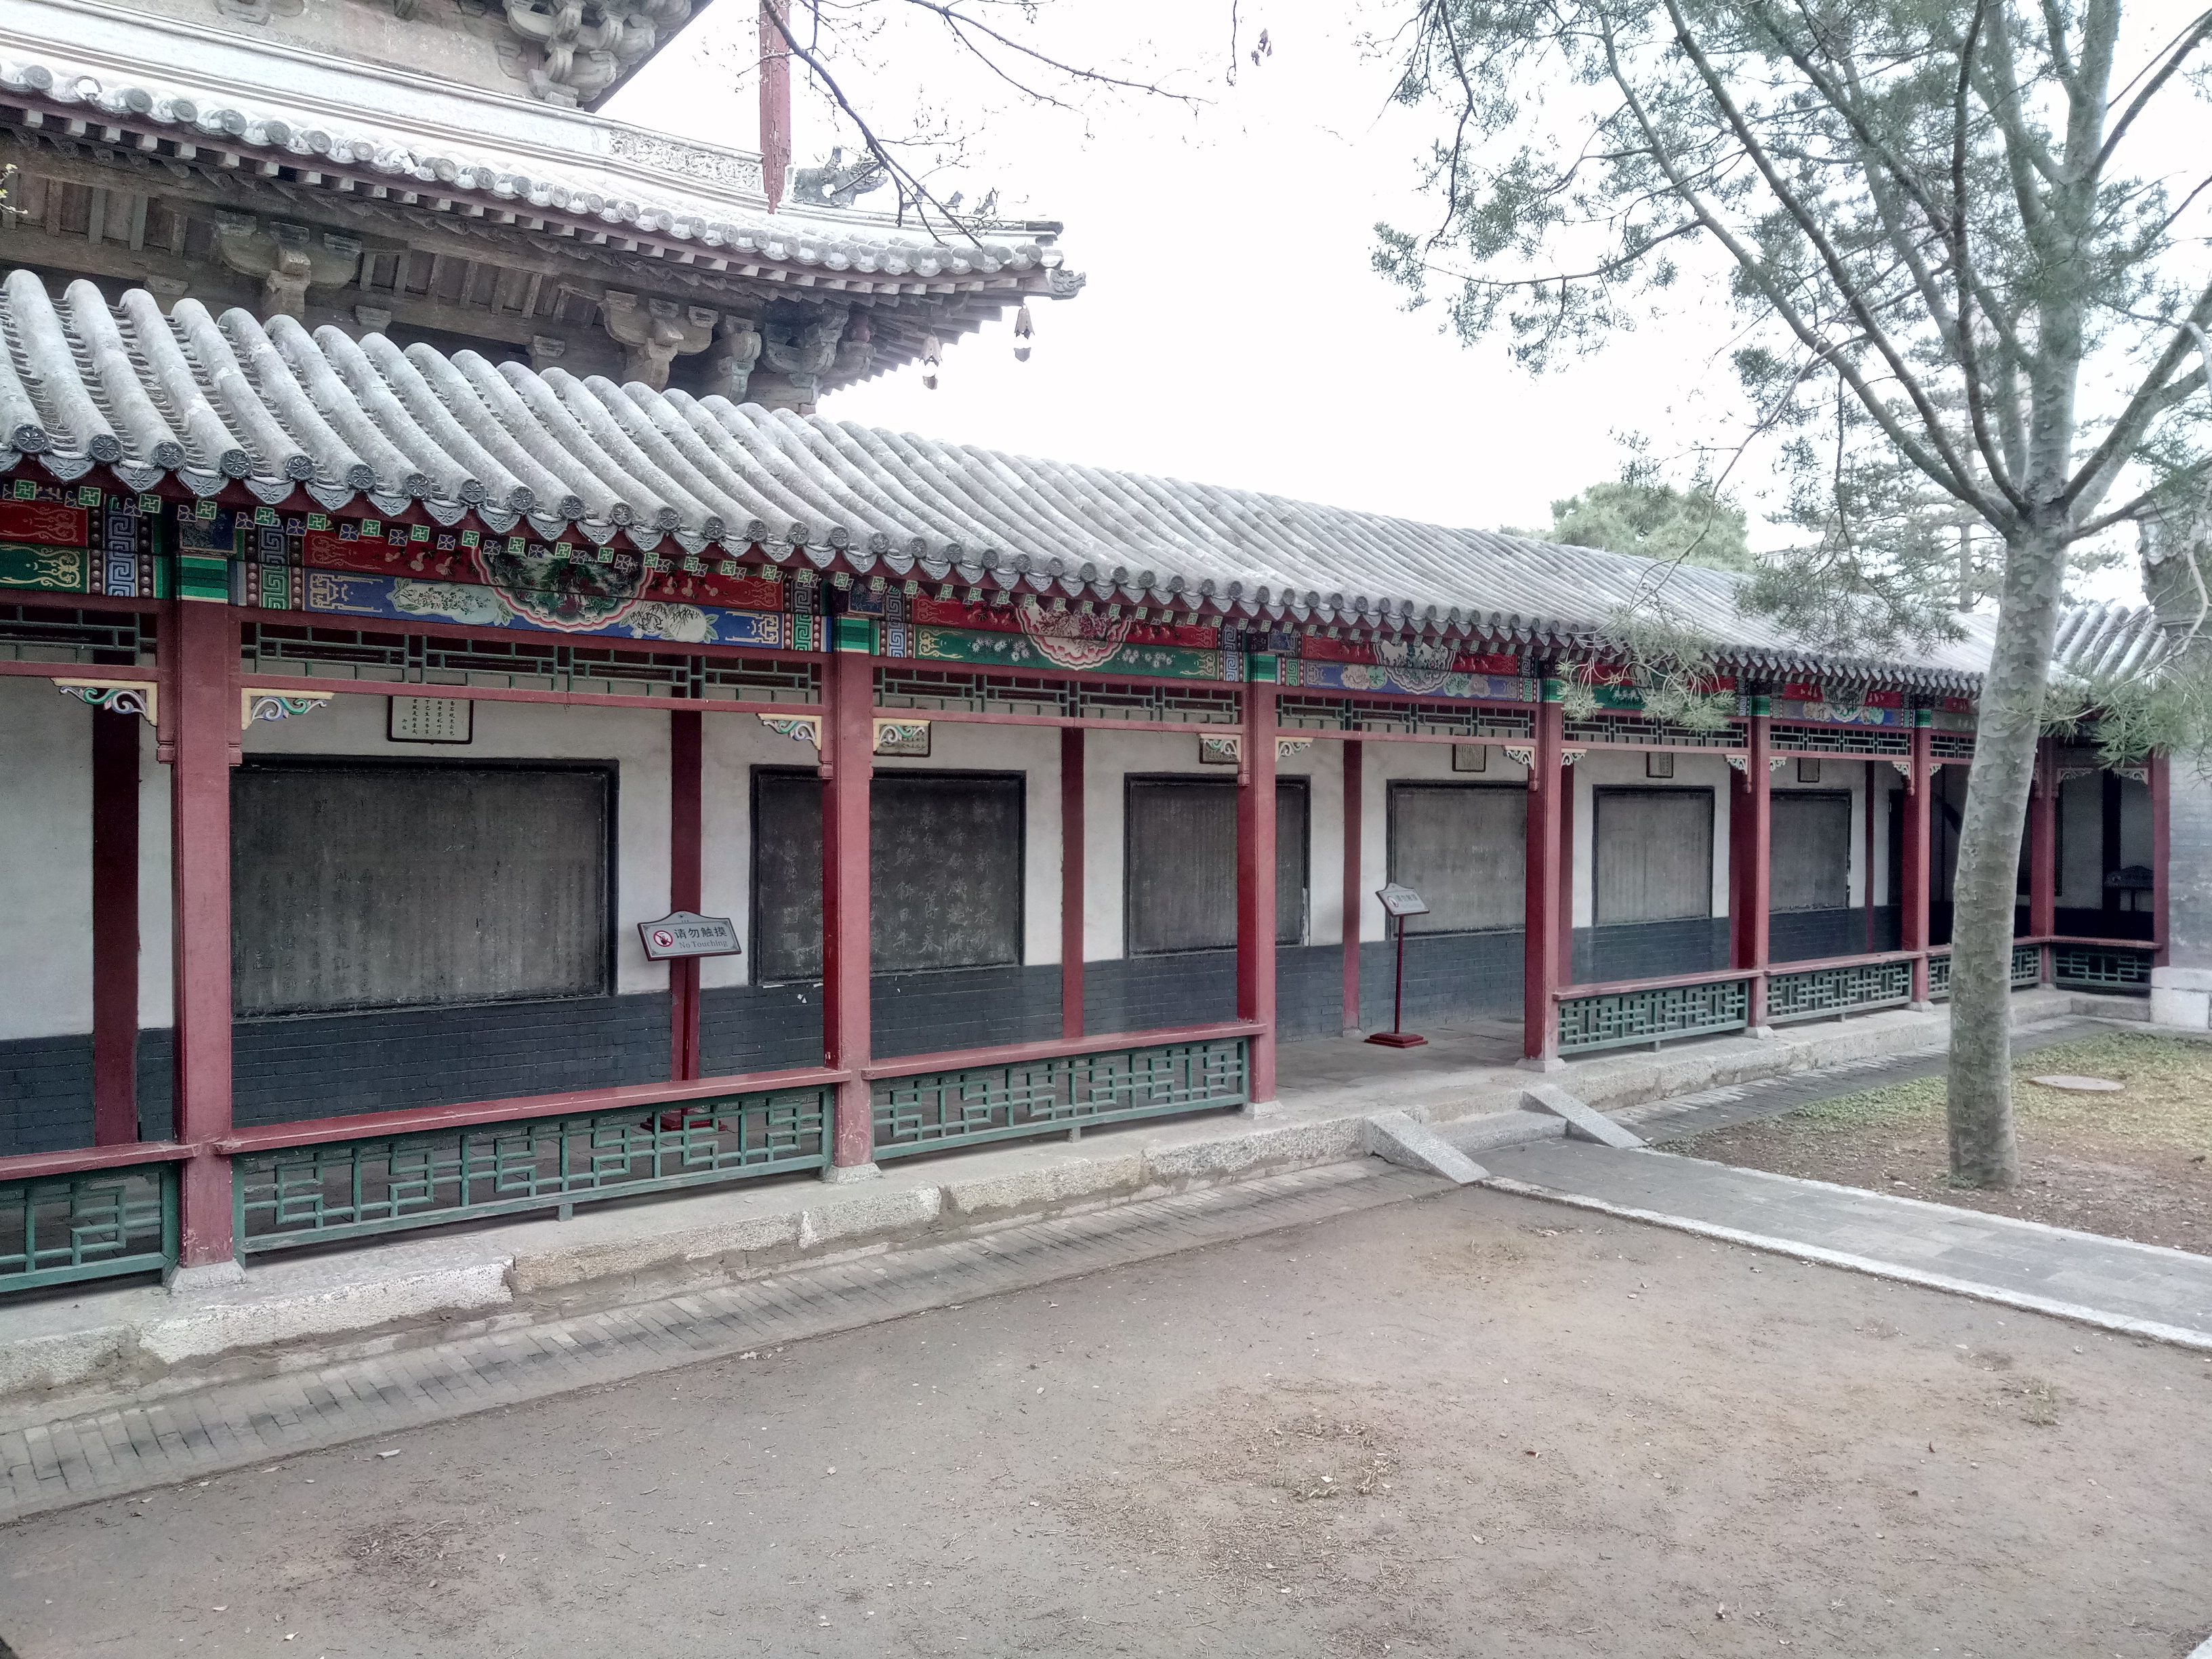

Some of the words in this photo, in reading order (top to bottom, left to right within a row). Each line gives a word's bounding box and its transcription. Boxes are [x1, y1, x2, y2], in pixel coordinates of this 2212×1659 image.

[674, 926, 728, 939] 请勿触摸
[691, 940, 729, 948] Touching
